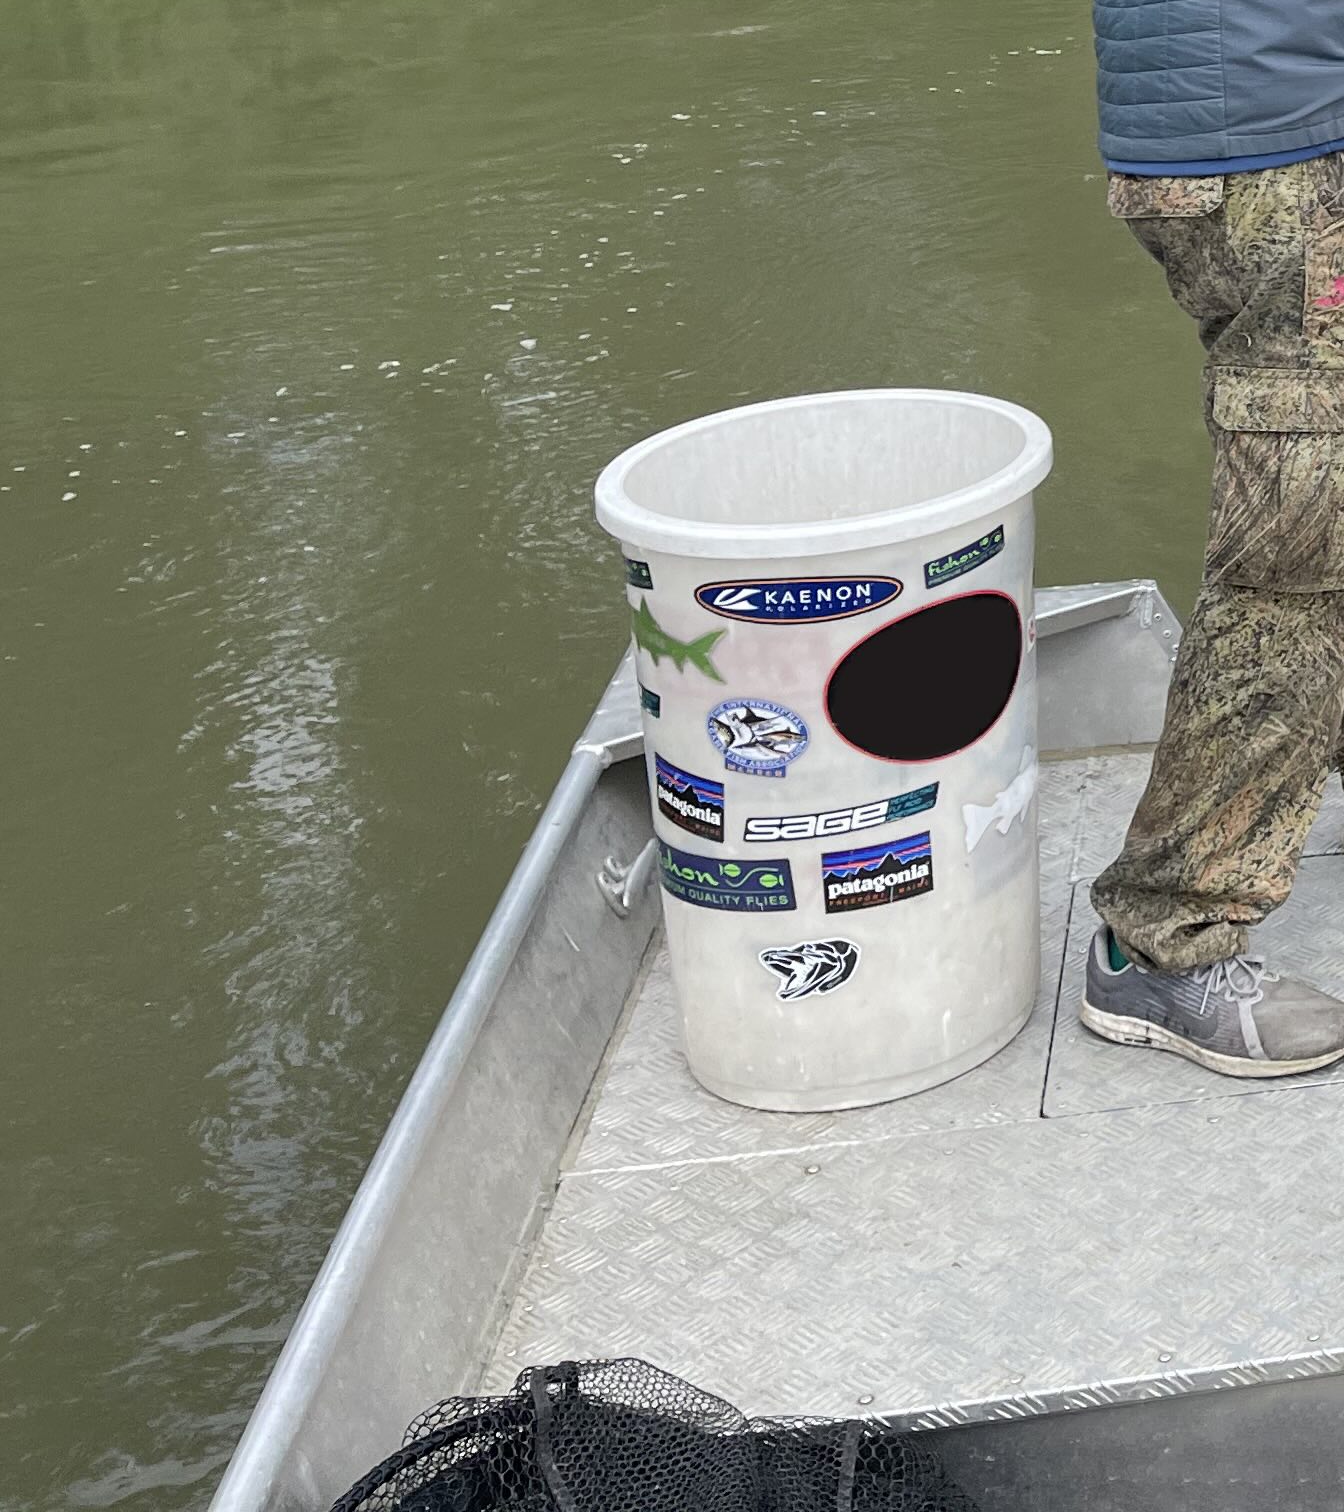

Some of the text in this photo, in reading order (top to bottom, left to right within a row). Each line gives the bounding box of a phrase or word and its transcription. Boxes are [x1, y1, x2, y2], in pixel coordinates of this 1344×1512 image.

[928, 549, 981, 577] fishon
[765, 583, 871, 605] KAENON
[659, 784, 721, 826] patagonia
[828, 863, 930, 900] patagonia
[688, 888, 789, 906] QUALITY FLIES
